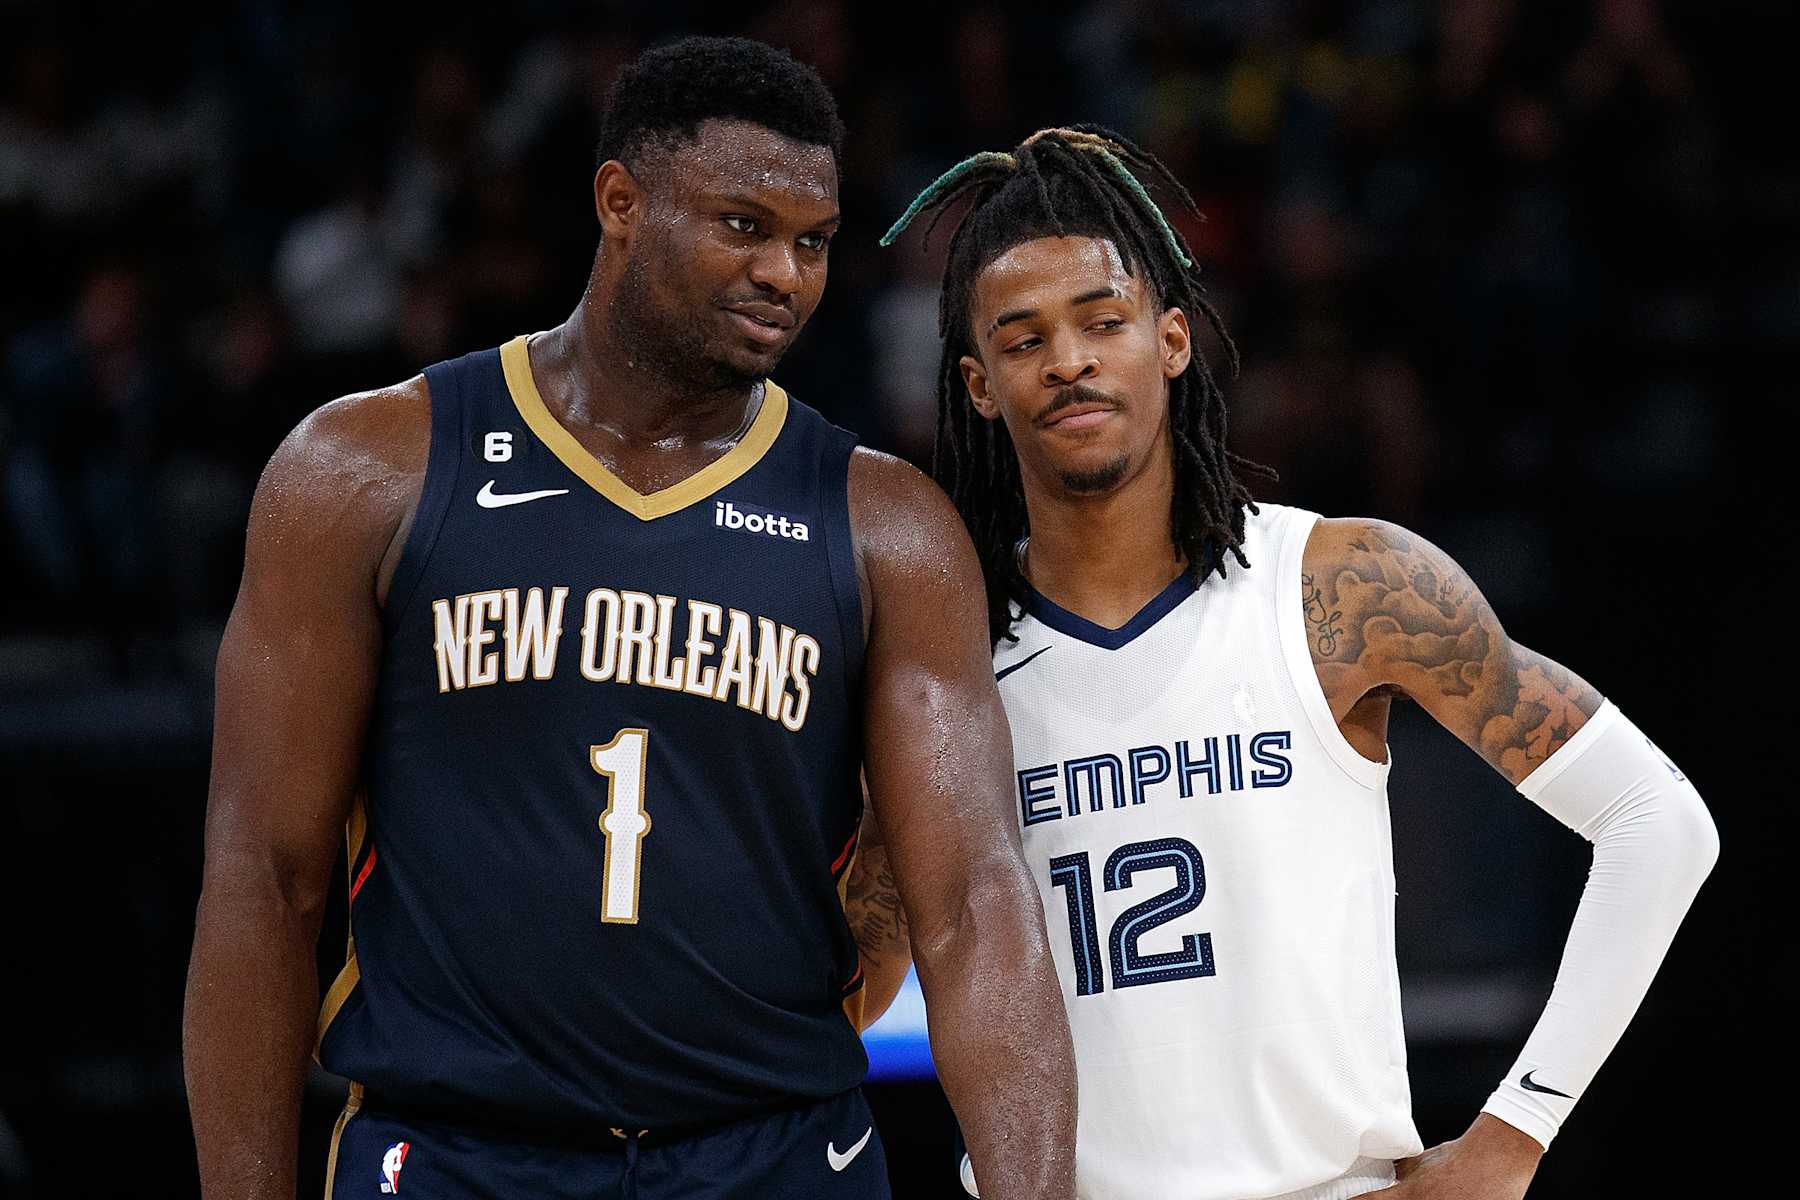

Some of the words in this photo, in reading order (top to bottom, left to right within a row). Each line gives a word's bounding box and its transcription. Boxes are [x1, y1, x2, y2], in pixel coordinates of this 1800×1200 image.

[484, 432, 513, 462] 6
[715, 501, 810, 542] ibotta
[432, 586, 569, 693] NEW
[581, 587, 821, 732] ORLEANS
[590, 728, 652, 924] 1
[1017, 731, 1293, 828] EMPHIS
[1049, 837, 1216, 997] 12
